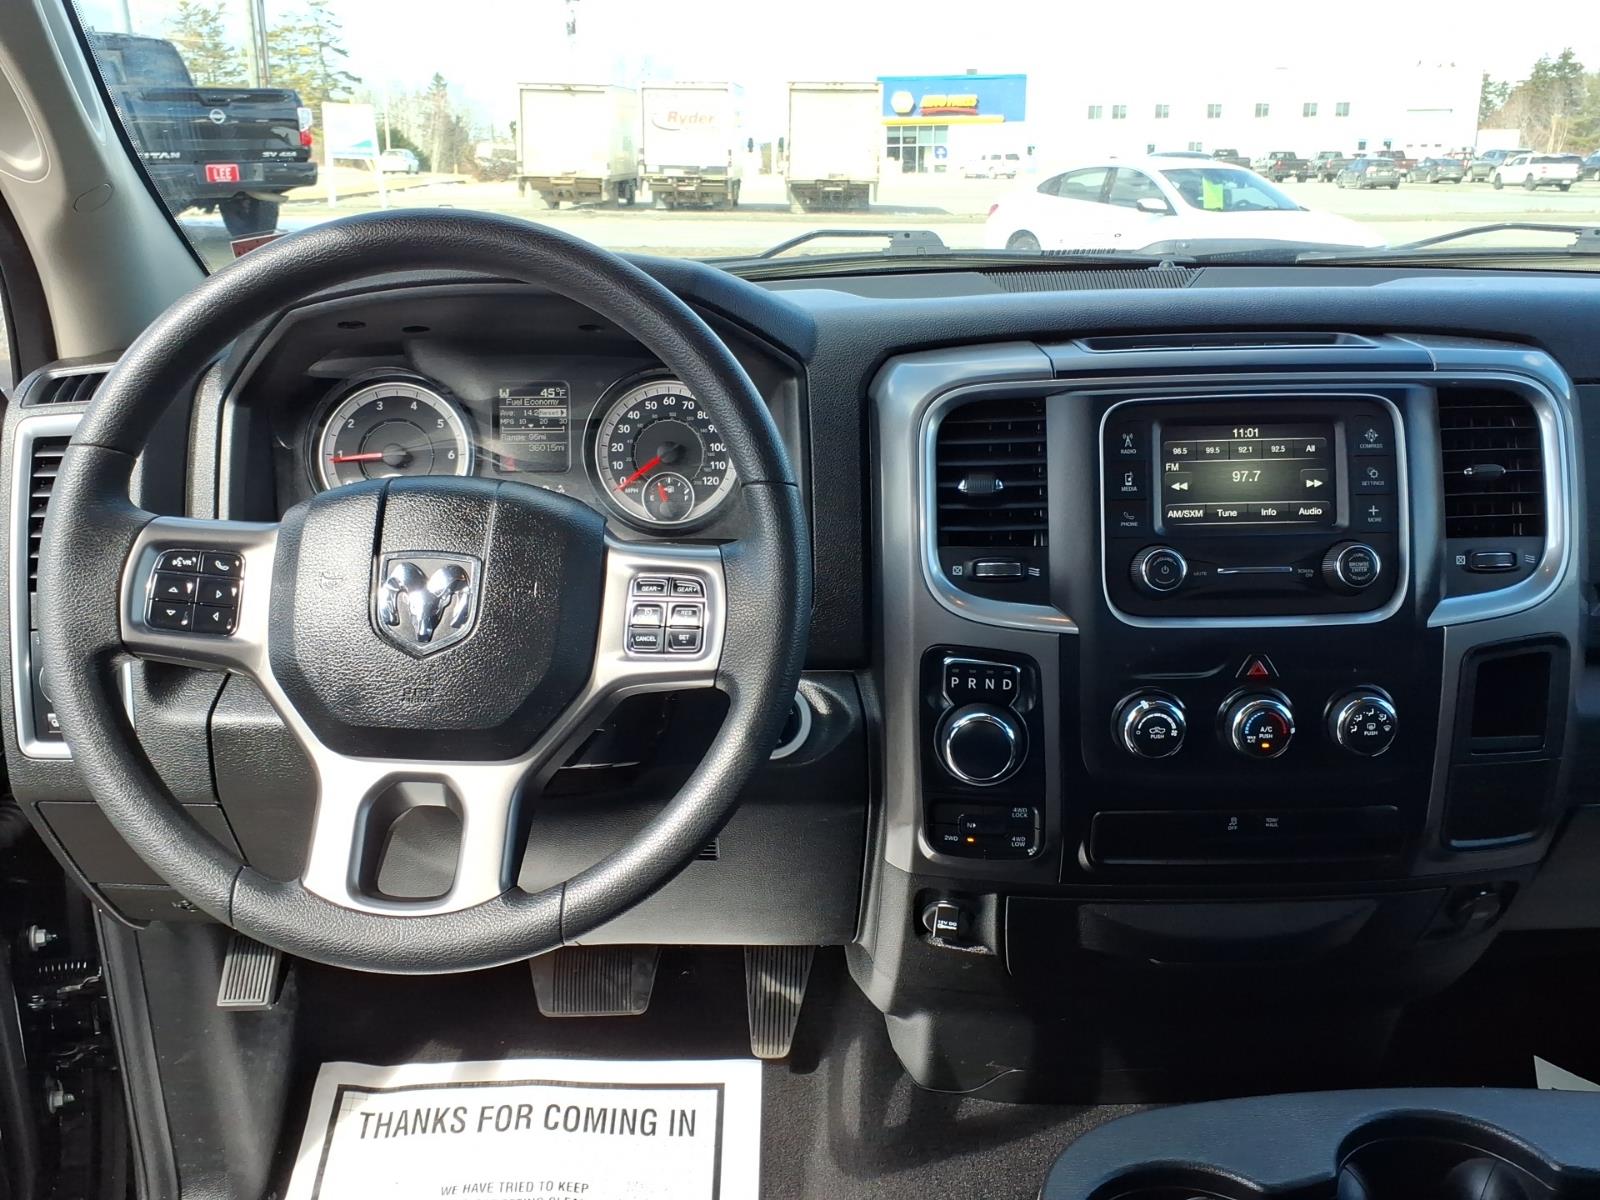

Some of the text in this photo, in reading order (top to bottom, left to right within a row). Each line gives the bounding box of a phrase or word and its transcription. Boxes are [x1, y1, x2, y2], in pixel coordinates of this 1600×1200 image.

[667, 111, 715, 125] Ryder
[213, 168, 232, 179] LEE
[499, 389, 509, 398] W
[524, 398, 560, 406] Economy
[663, 397, 675, 405] 60
[682, 401, 695, 409] 70
[377, 401, 383, 410] 3
[411, 402, 417, 410] 4
[645, 402, 658, 410] 50
[627, 411, 640, 419] 40
[348, 420, 354, 428] 2
[437, 420, 444, 428] 5
[618, 425, 630, 433] 30
[708, 425, 717, 433] 9
[1232, 428, 1259, 438] 11:01
[611, 443, 624, 452] 20
[1271, 445, 1286, 453] 92.5
[448, 451, 455, 459] 6
[612, 462, 623, 470] 10
[710, 462, 726, 470] 110
[1165, 463, 1179, 471] FM
[1232, 470, 1261, 482] 97.7
[702, 477, 720, 485] 120
[1167, 507, 1322, 518] AM/SXM Tune Info Audio
[951, 677, 1012, 690] P R N D
[360, 1103, 696, 1139] THANKS FOR COMING IN
[441, 1180, 589, 1196] WE HAVE TRIED TO KEEP
